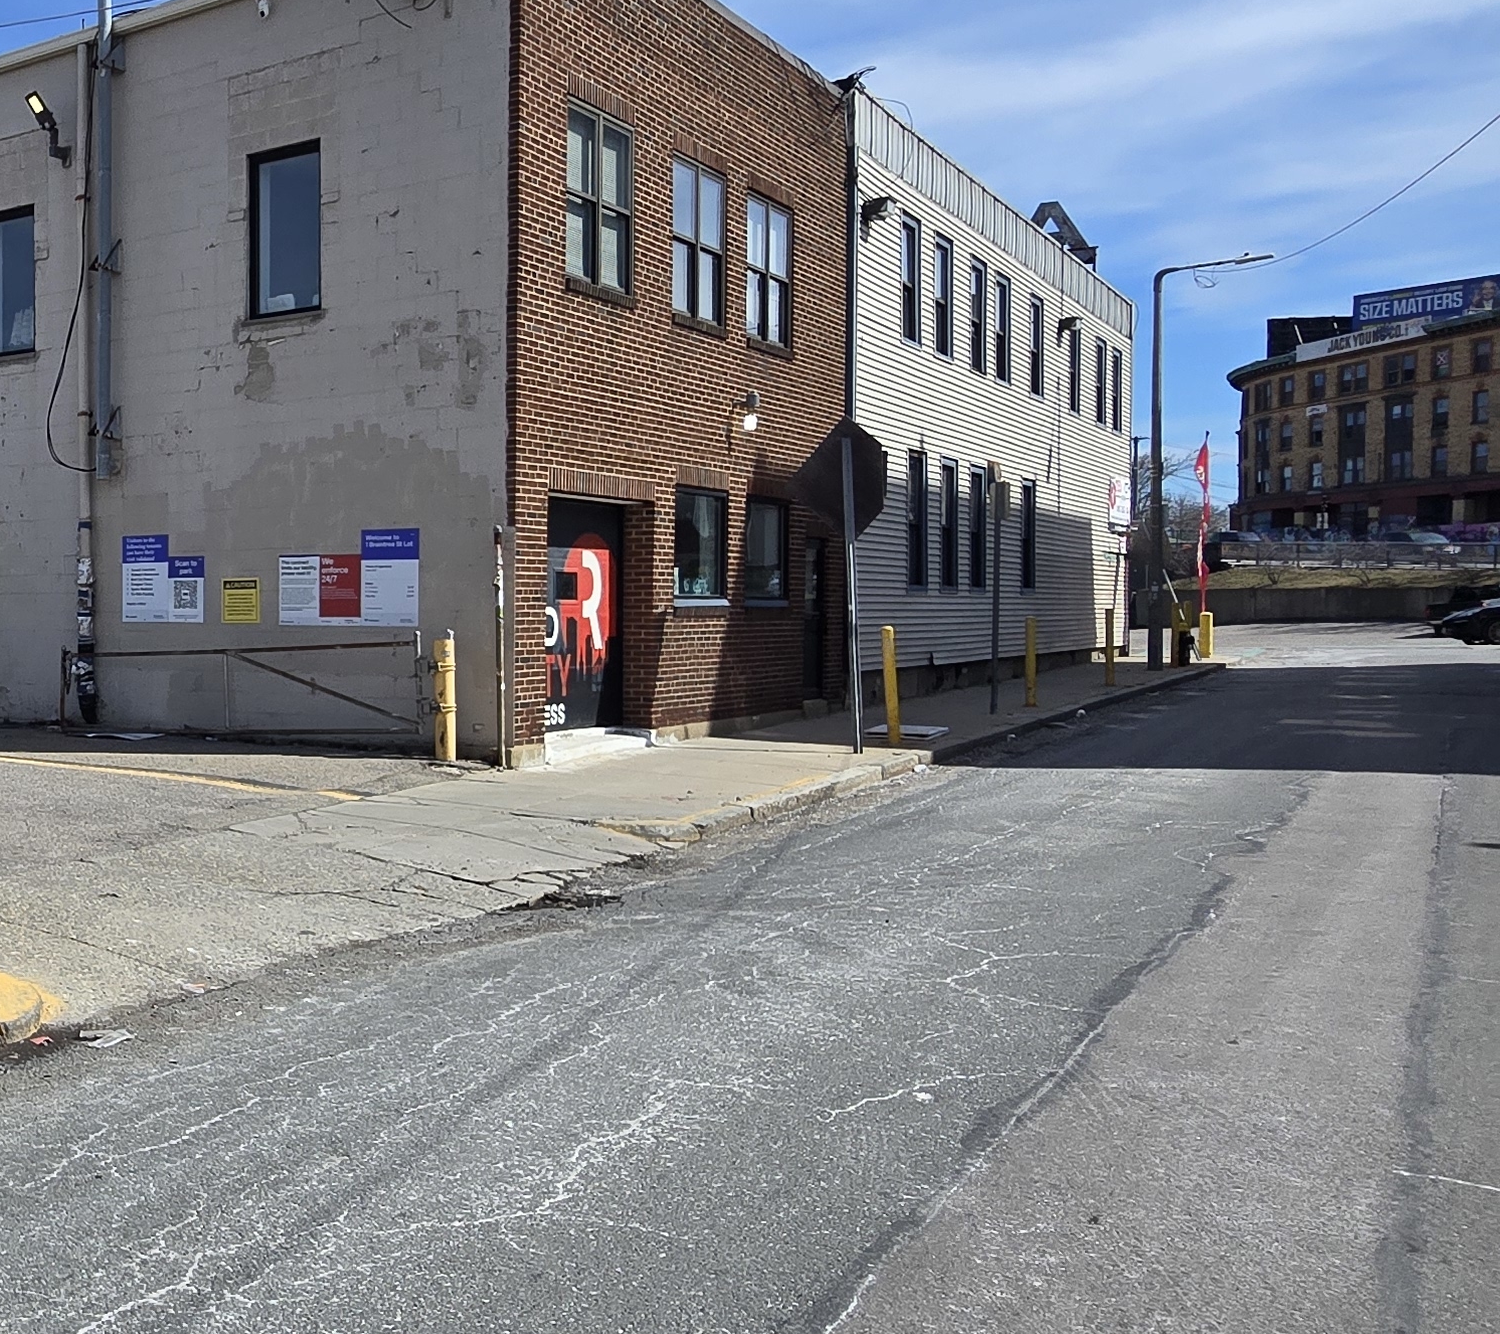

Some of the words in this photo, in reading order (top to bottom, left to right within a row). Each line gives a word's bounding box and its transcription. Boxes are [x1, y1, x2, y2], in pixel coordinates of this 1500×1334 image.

[1359, 301, 1391, 321] SIZE
[1392, 291, 1463, 317] MATTERS
[1327, 335, 1352, 353] JACK
[321, 557, 334, 565] We
[321, 566, 349, 574] enforce
[321, 575, 338, 584] 24/7
